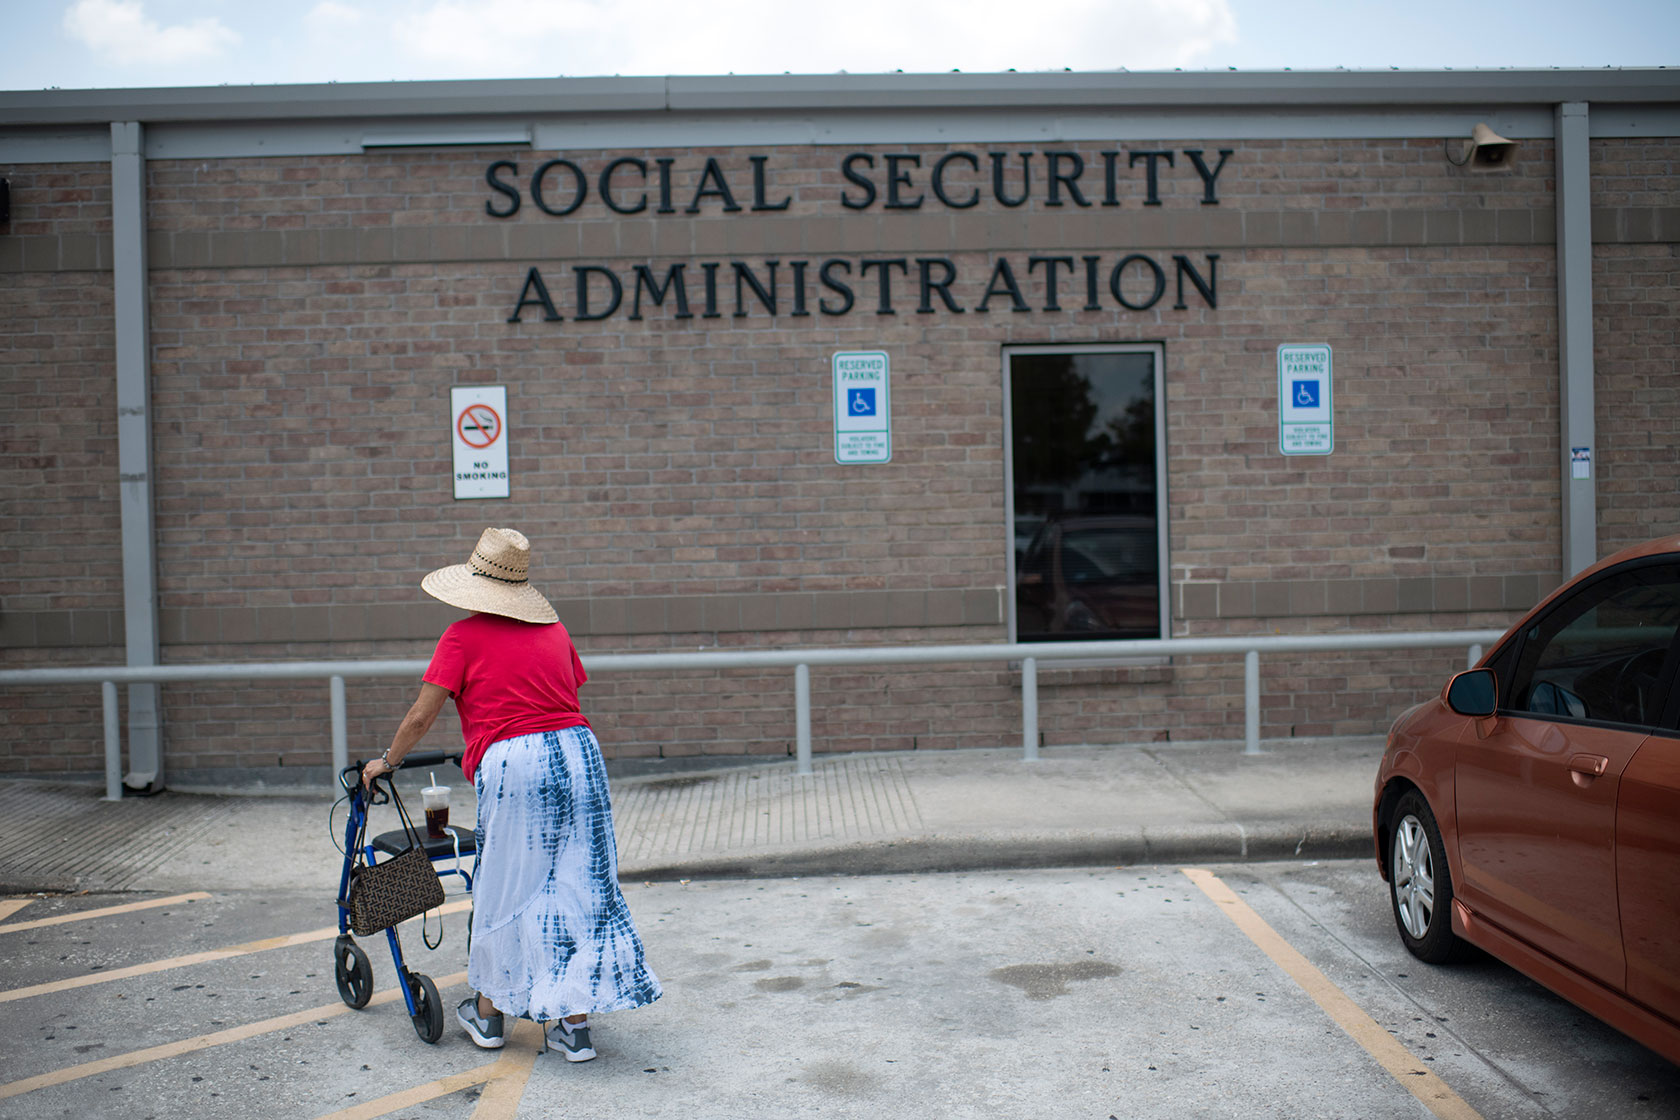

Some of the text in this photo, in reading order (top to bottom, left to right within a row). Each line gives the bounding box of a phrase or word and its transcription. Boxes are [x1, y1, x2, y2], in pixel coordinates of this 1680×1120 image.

[485, 149, 1234, 218] SOCIAL SECURITY
[507, 253, 1221, 323] ADMINISTRATION
[1284, 352, 1326, 362] RESERVED
[839, 359, 883, 370] RESERVED
[1287, 363, 1324, 374] PARKING
[842, 370, 881, 381] PARKING
[473, 461, 489, 470] NO
[456, 472, 506, 481] SMOKING
